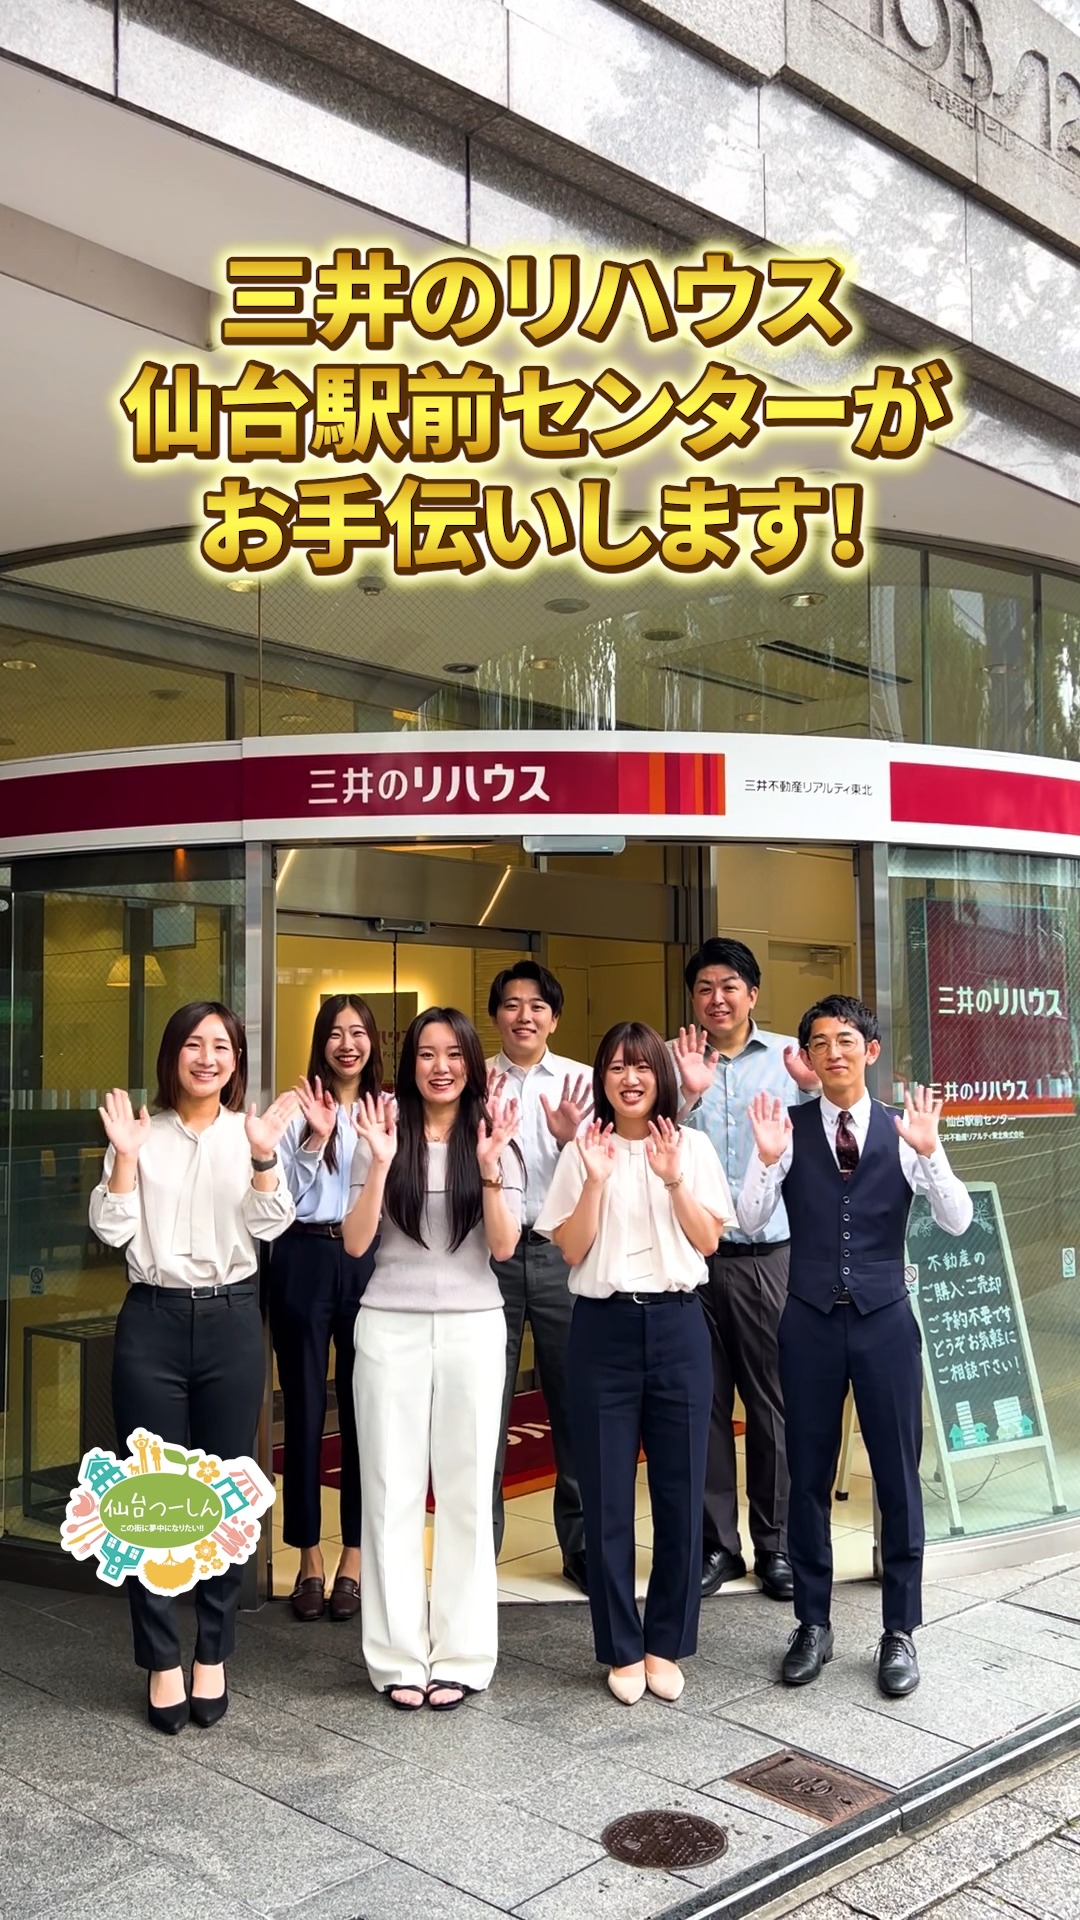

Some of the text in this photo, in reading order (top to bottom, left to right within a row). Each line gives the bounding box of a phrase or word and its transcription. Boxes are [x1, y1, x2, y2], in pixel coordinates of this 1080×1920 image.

[308, 763, 550, 804] 三井のリハウス
[744, 779, 873, 796] 三井不動産リアルティ東北
[938, 986, 1063, 1016] 三井のリハウス
[928, 1080, 1029, 1102] 三井のリハウス
[946, 1113, 1016, 1127] 仙台駅前センター
[927, 1248, 985, 1272] 不動産の
[928, 1304, 1011, 1334] ご予約不要です
[933, 1328, 1017, 1358] どうぞお気軽に
[938, 1356, 1021, 1384] ご相談下さい!
